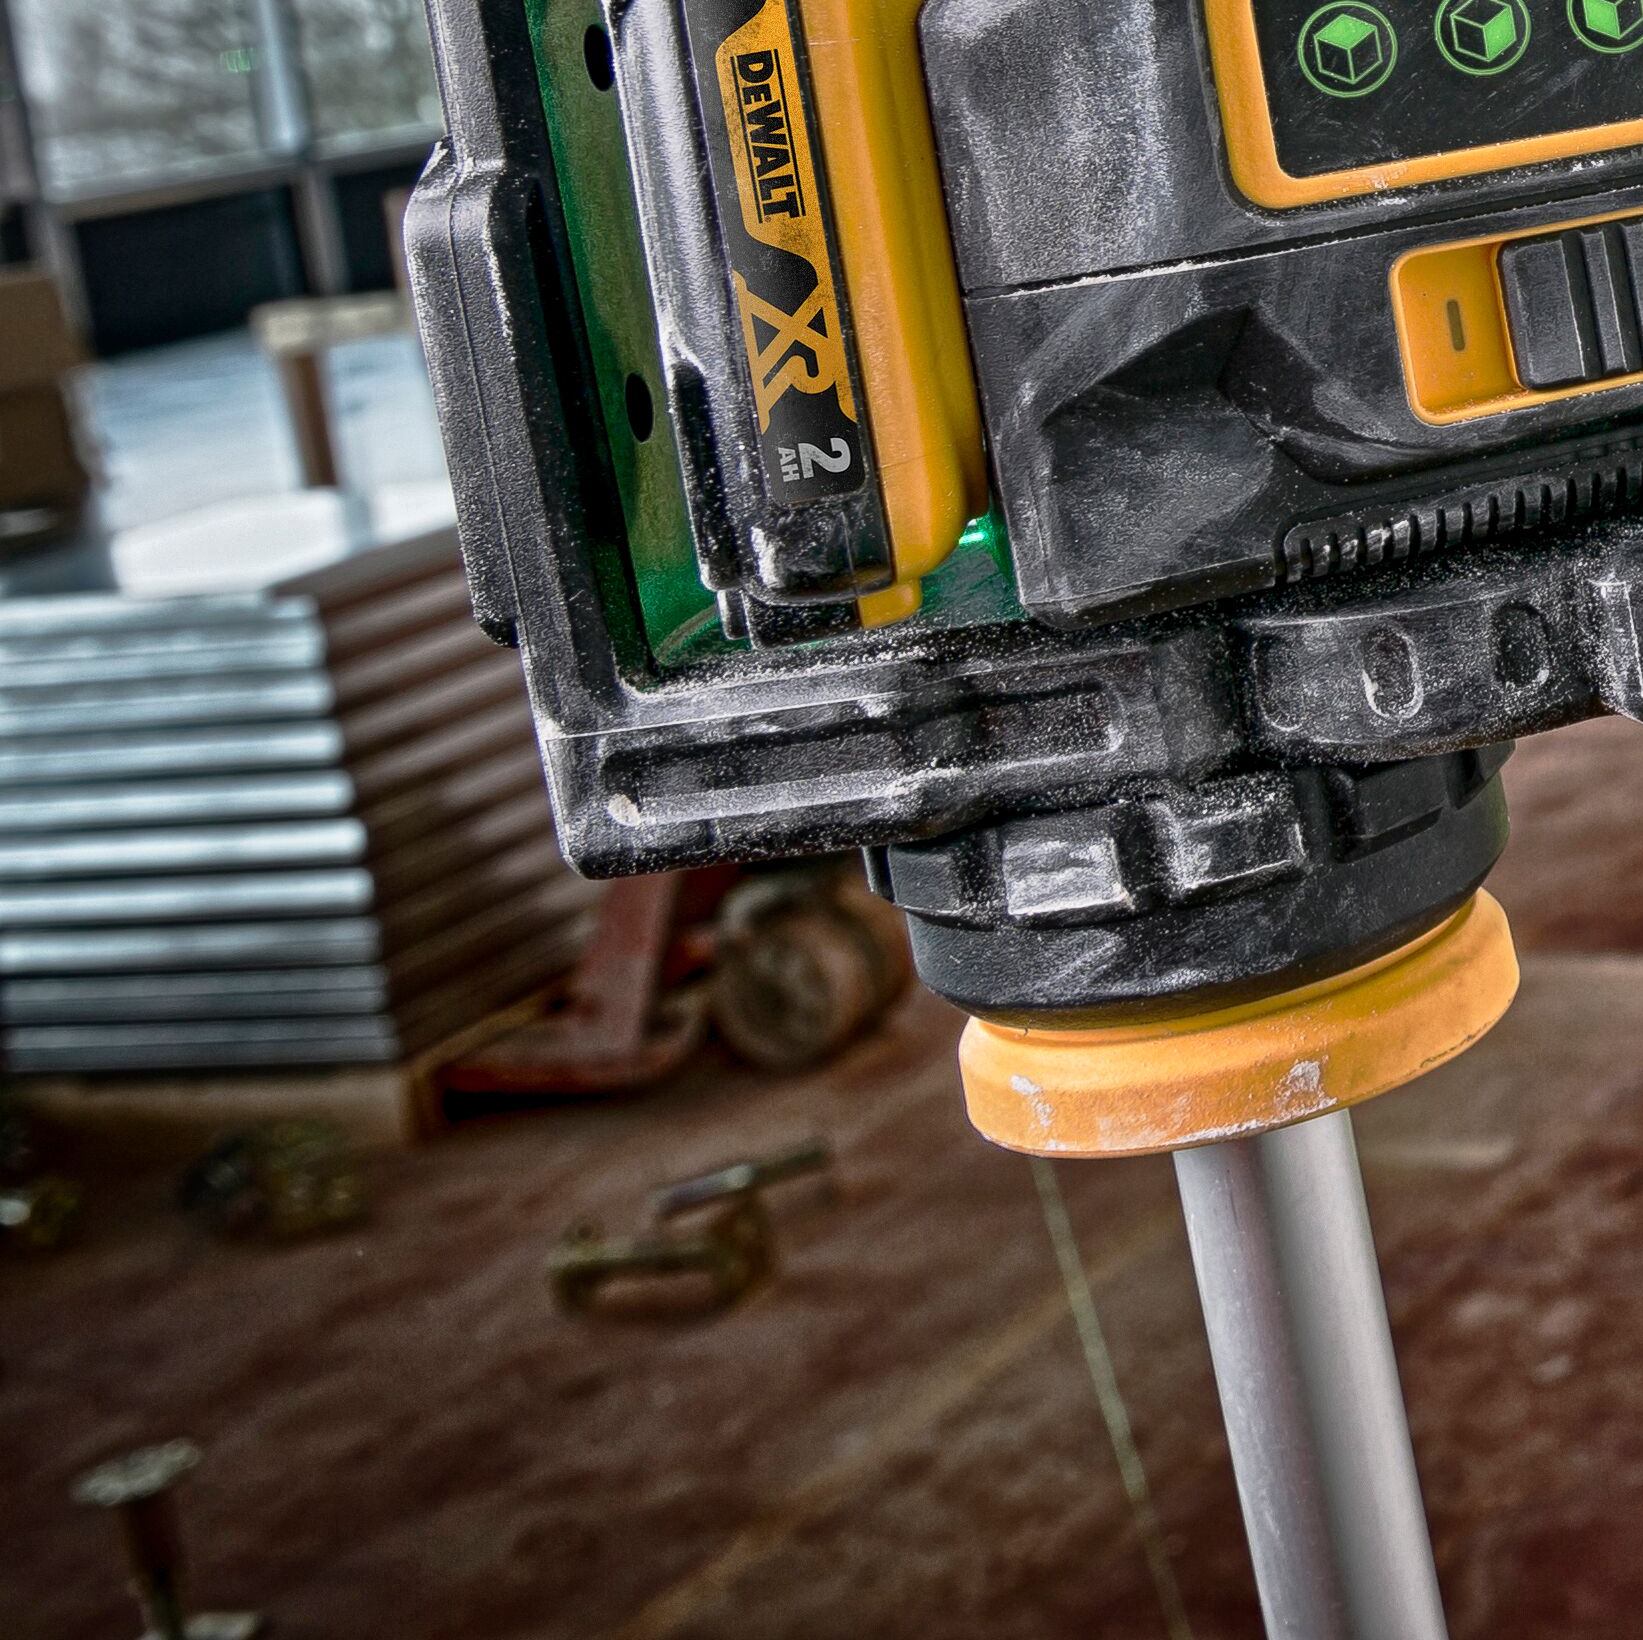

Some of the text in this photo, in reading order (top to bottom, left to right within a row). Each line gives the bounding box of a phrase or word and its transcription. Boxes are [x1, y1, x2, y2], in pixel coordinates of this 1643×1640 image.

[735, 48, 801, 220] DEWALT
[735, 272, 850, 434] XR
[777, 446, 800, 483] AH
[797, 437, 851, 480] 2
